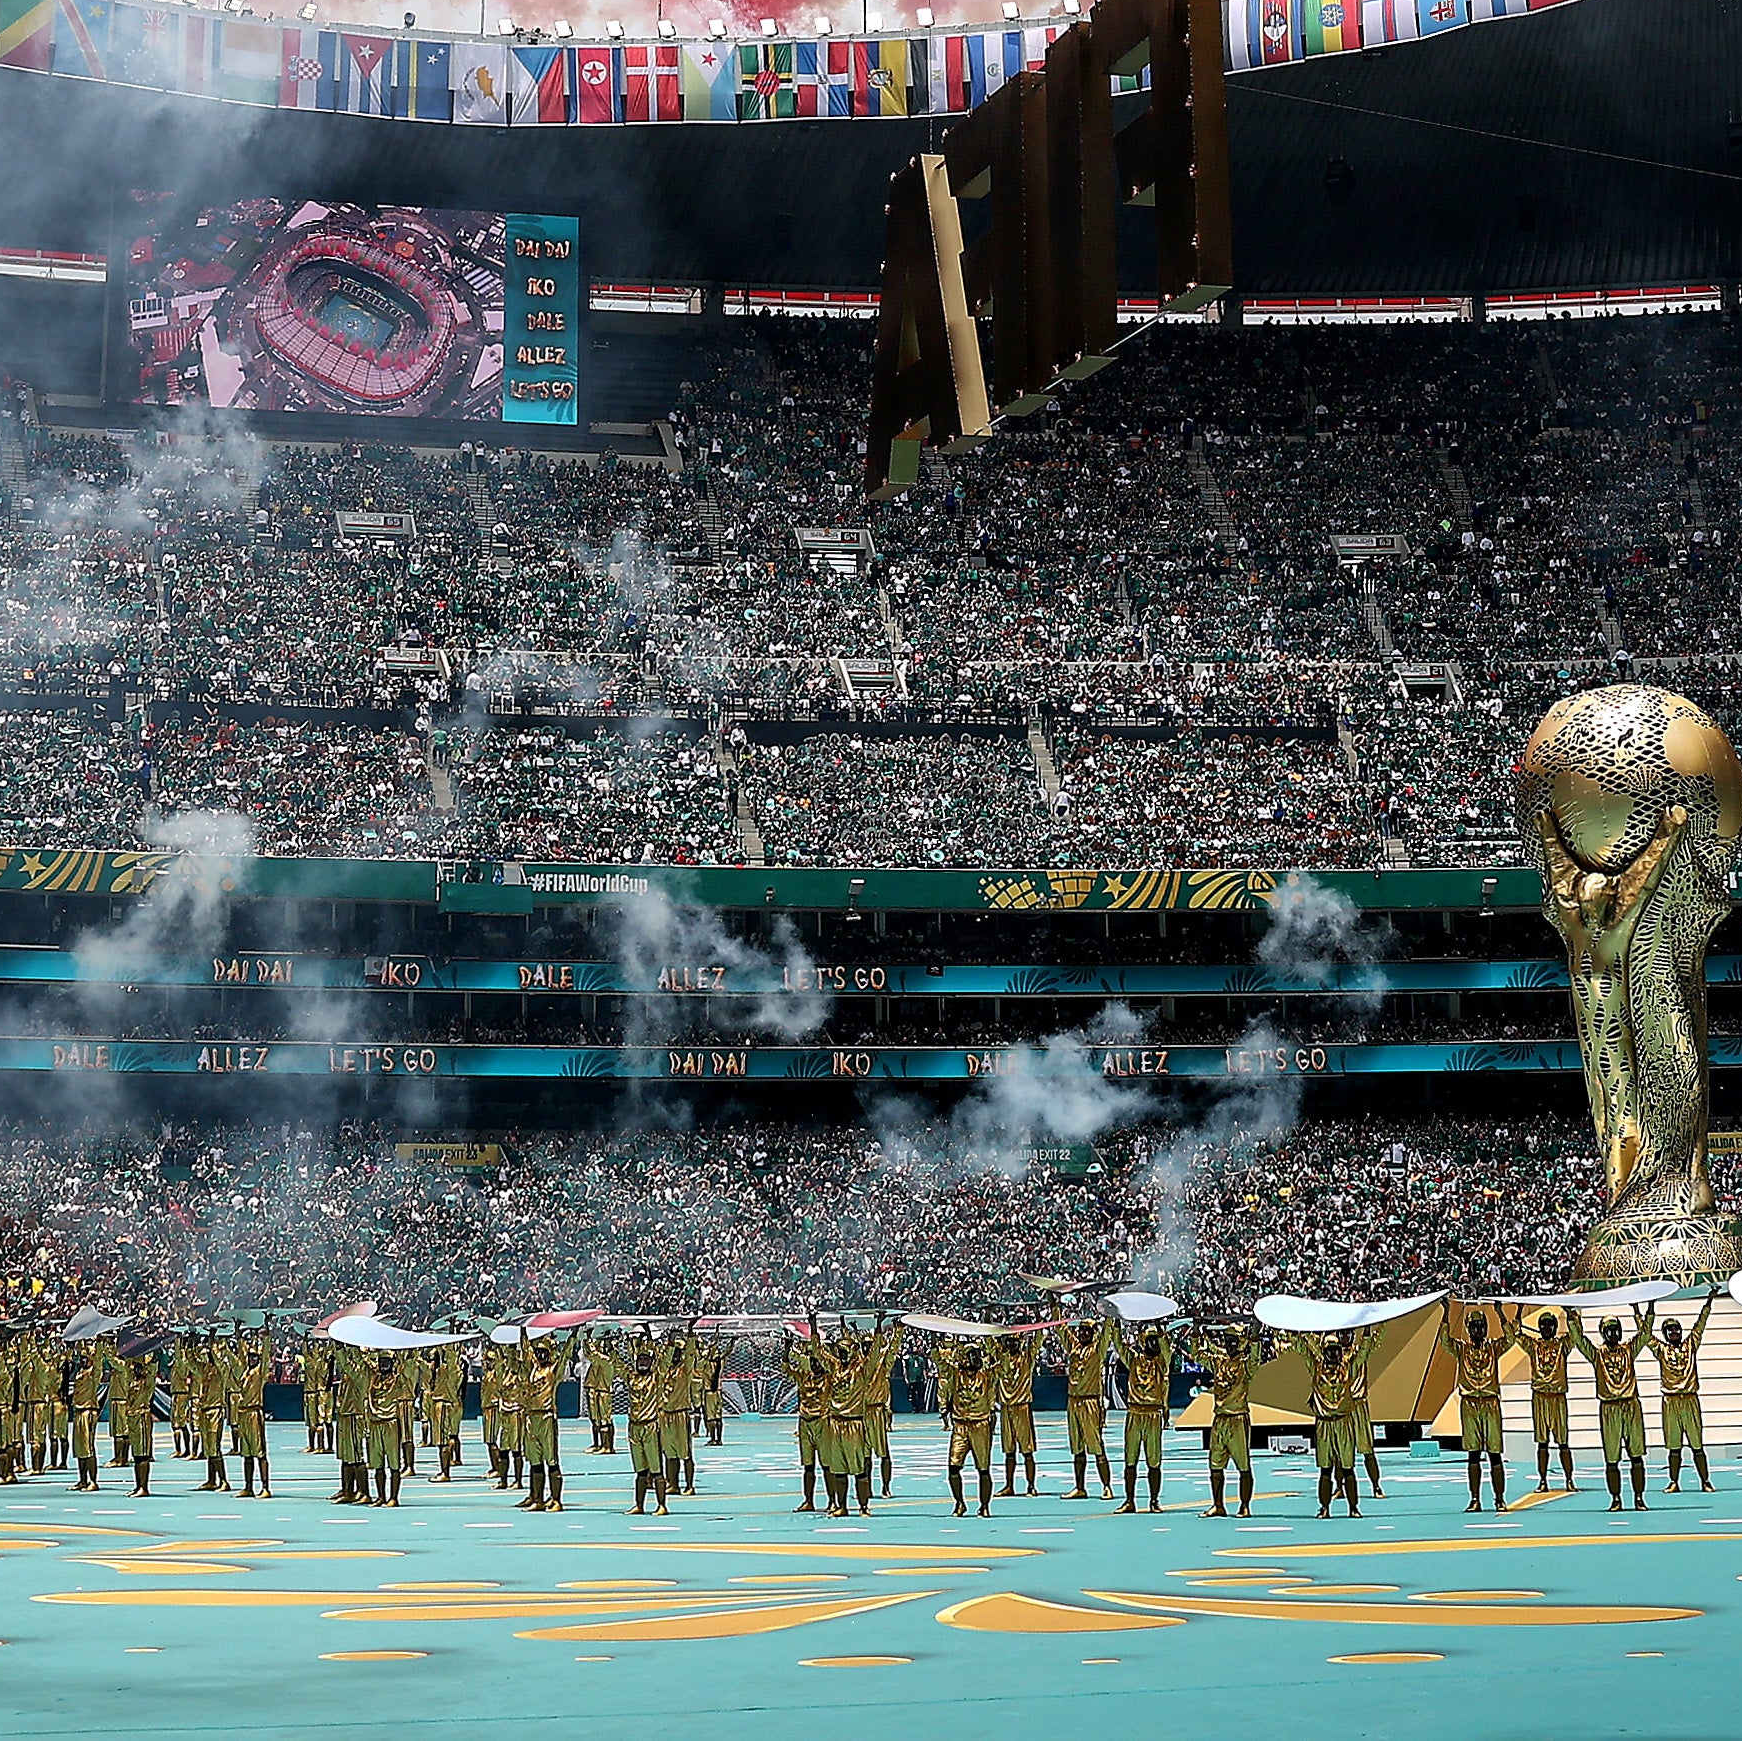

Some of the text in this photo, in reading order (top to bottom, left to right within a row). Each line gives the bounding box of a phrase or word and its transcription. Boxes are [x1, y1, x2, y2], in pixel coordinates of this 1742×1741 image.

[516, 238, 570, 258] DAI DAI
[527, 277, 555, 296] IKO
[527, 311, 565, 331] DALE
[516, 346, 566, 365] ALLEZ
[387, 518, 400, 527] 65
[844, 533, 857, 542] 64
[421, 652, 434, 662] 23
[880, 663, 893, 673] 22
[1432, 665, 1443, 674] 21
[532, 873, 648, 894] #FIFAWorldCup
[212, 957, 293, 984] DAI DAI
[380, 962, 422, 986] IKO
[518, 965, 574, 989] DALE
[657, 967, 725, 991] ALLEZ
[784, 967, 885, 992] LET'S GO
[53, 1046, 110, 1070] DALE
[197, 1046, 269, 1072] ALLEZ
[330, 1047, 436, 1072] LET'S GO
[669, 1052, 746, 1075] DAI DAI
[832, 1052, 870, 1075] IKO
[1102, 1050, 1169, 1075] ALLEZ
[1226, 1048, 1326, 1072] LET'S GO
[1040, 1149, 1057, 1160] EXIT
[1058, 1149, 1070, 1160] 22
